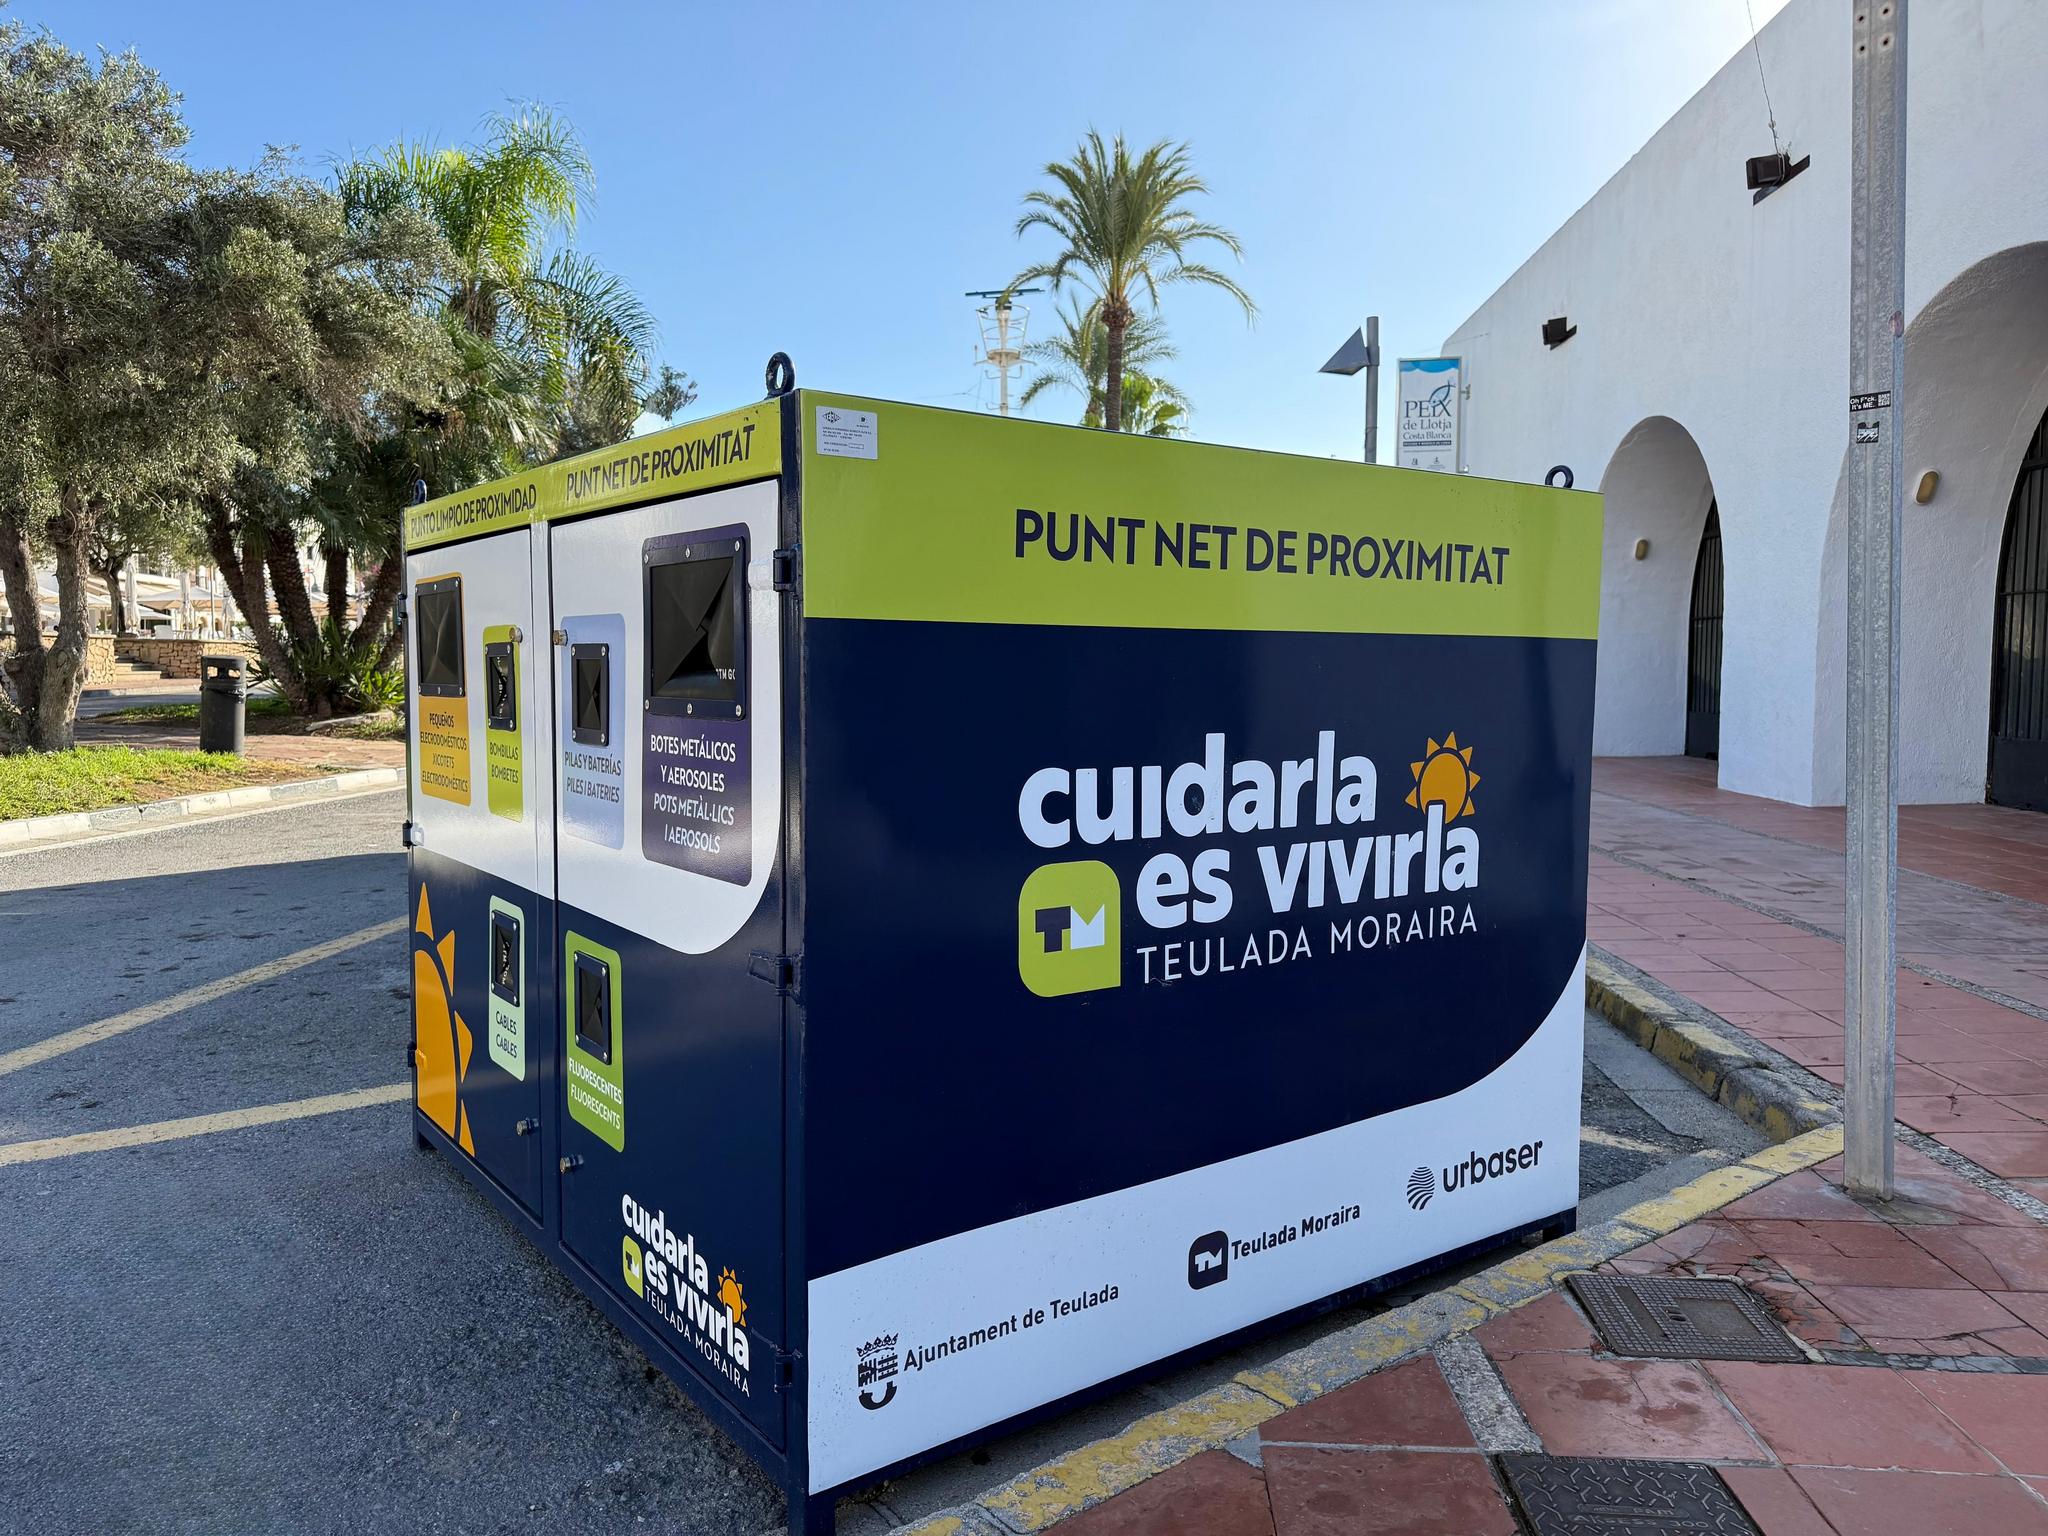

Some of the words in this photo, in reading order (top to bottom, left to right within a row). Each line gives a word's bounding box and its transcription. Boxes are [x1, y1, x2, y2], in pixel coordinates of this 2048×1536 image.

[1403, 419, 1417, 430] de
[1420, 418, 1452, 432] Llotja
[1403, 432, 1425, 440] Costa
[1426, 431, 1452, 440] Blanca
[566, 467, 599, 501] PUNT
[601, 457, 629, 493] NET
[630, 452, 650, 486] DE
[651, 424, 756, 480] PROXIMITAT
[411, 512, 436, 539] PUNTO
[436, 504, 462, 533] LIMPIO
[463, 499, 475, 525] DE
[476, 484, 537, 522] PROXIMIDAD
[1014, 508, 1146, 564] PUNT
[1154, 520, 1238, 570] NET
[1245, 528, 1298, 574] DE
[1306, 531, 1510, 585] PROXIMITAT
[489, 742, 519, 760] BOMBILLAS
[564, 751, 582, 769] PILAS
[582, 754, 588, 769] Y
[588, 753, 622, 777] BATERÍAS
[650, 734, 679, 755] BOTES
[680, 734, 736, 762] METÁLICOS
[491, 764, 519, 784] BOMBETES
[566, 777, 583, 795] PILES
[587, 782, 620, 803] BATERIES
[660, 764, 667, 783] Y
[668, 767, 725, 792] AEROSOLES
[1018, 730, 1378, 849] cuidarla
[654, 792, 677, 814] POTS
[664, 823, 668, 841] I
[668, 826, 721, 854] AEROSOLS
[1136, 848, 1234, 929] es
[1256, 804, 1480, 914] vivirla
[1034, 903, 1106, 954] TM
[1136, 924, 1313, 984] TEULADA
[1330, 903, 1478, 955] MORAIRA
[495, 1010, 517, 1036] CABLES
[495, 1033, 518, 1059] CABLES
[568, 1057, 622, 1105] FLUORESCENTES
[570, 1083, 621, 1131] FLUORESCENTS
[1442, 1140, 1544, 1193] urbaser
[622, 1193, 709, 1295] cuidarla
[1230, 1224, 1297, 1260] Teulada
[1301, 1203, 1361, 1237] Moraira
[644, 1250, 669, 1296] es
[673, 1273, 750, 1371] vivirla
[904, 1315, 1018, 1372] Ajuntament
[1022, 1307, 1045, 1329] de
[1050, 1283, 1120, 1319] Teulada
[645, 1284, 692, 1343] TEULADA
[695, 1335, 750, 1398] MORAIRA
